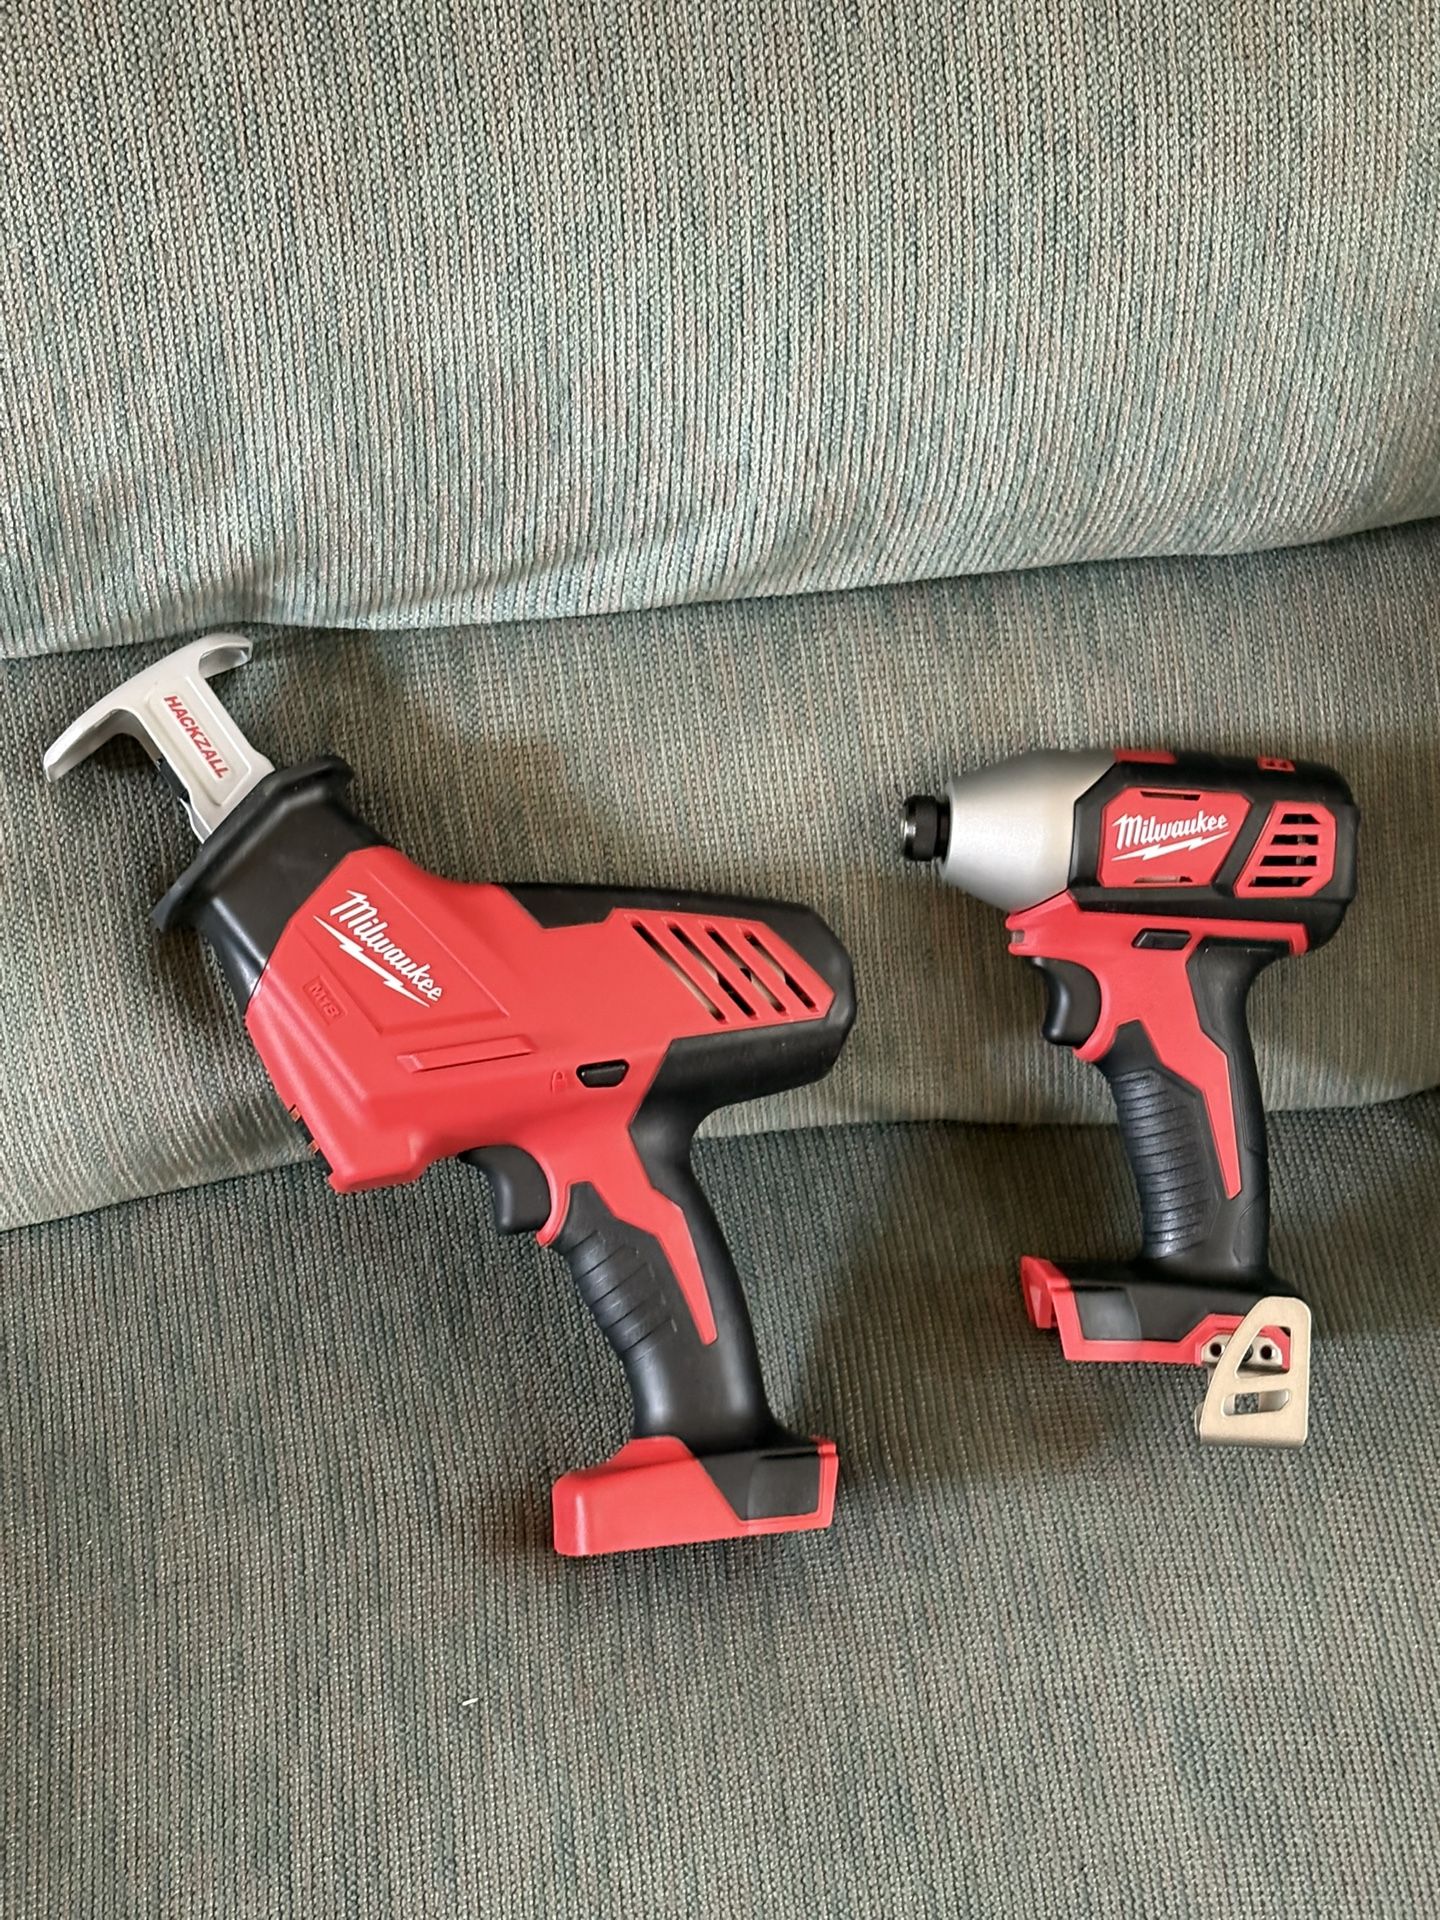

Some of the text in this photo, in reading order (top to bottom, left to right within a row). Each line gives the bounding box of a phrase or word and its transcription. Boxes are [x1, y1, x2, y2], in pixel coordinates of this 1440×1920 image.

[163, 695, 229, 779] HACKZALL
[1111, 810, 1229, 850] Milwaukee
[329, 889, 443, 1002] Milwaukee
